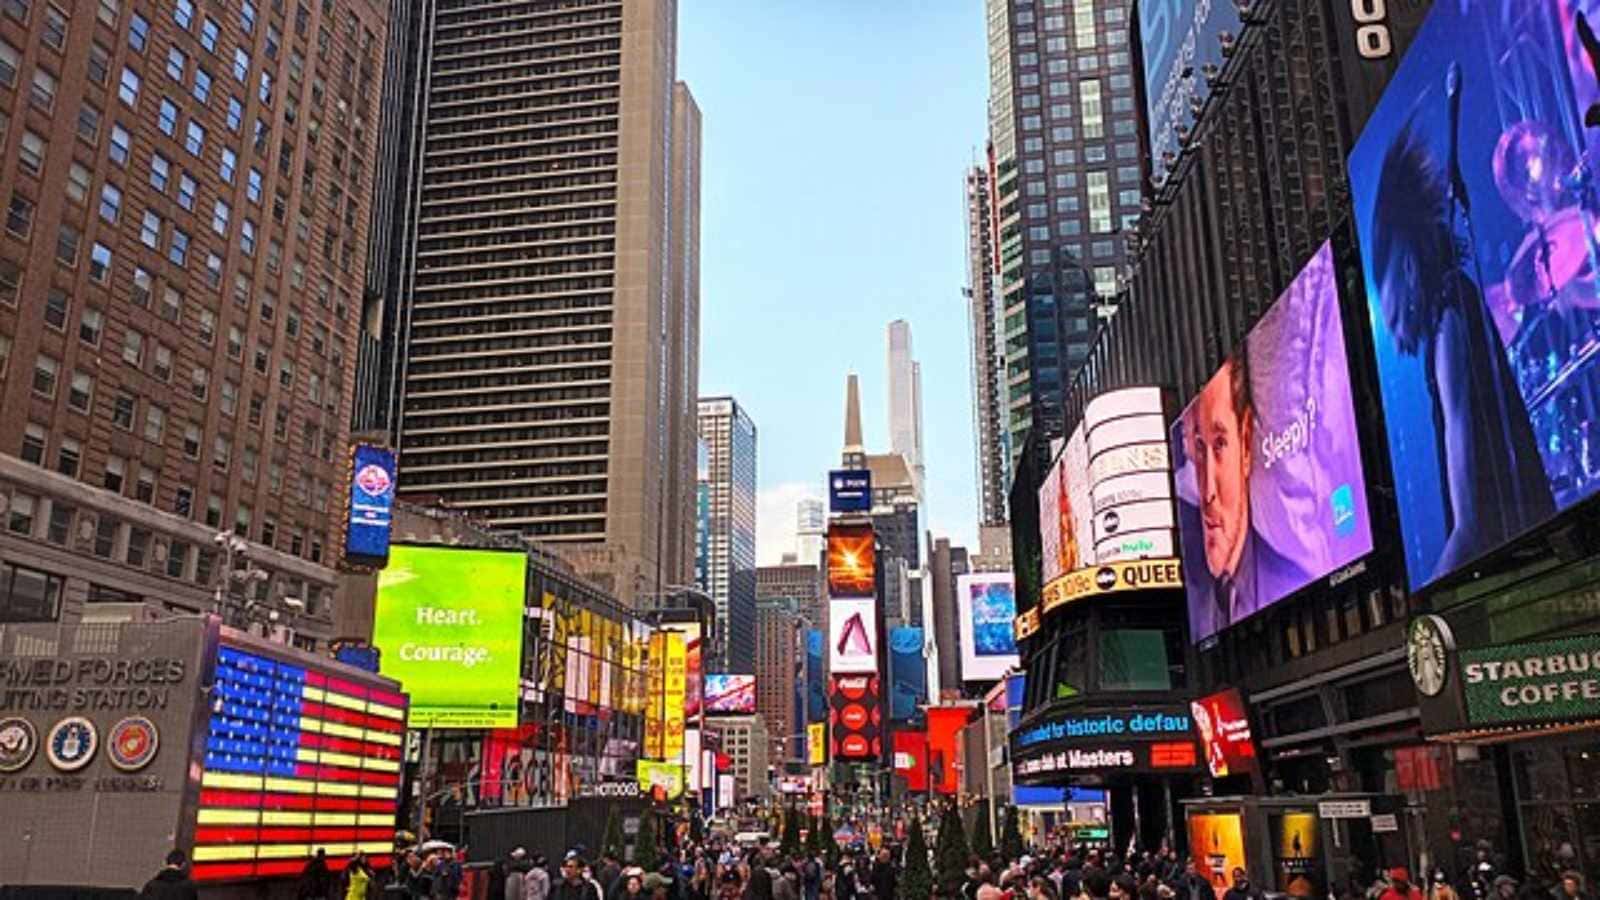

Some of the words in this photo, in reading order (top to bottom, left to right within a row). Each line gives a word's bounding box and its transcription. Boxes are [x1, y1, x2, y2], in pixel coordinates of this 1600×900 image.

[1262, 397, 1316, 468] Sleepy?
[416, 606, 481, 625] Heart.
[400, 642, 492, 668] Courage.
[77, 658, 186, 684] FORCES
[73, 688, 169, 711] STATION
[1066, 715, 1125, 736] historic
[1068, 749, 1133, 768] Masters
